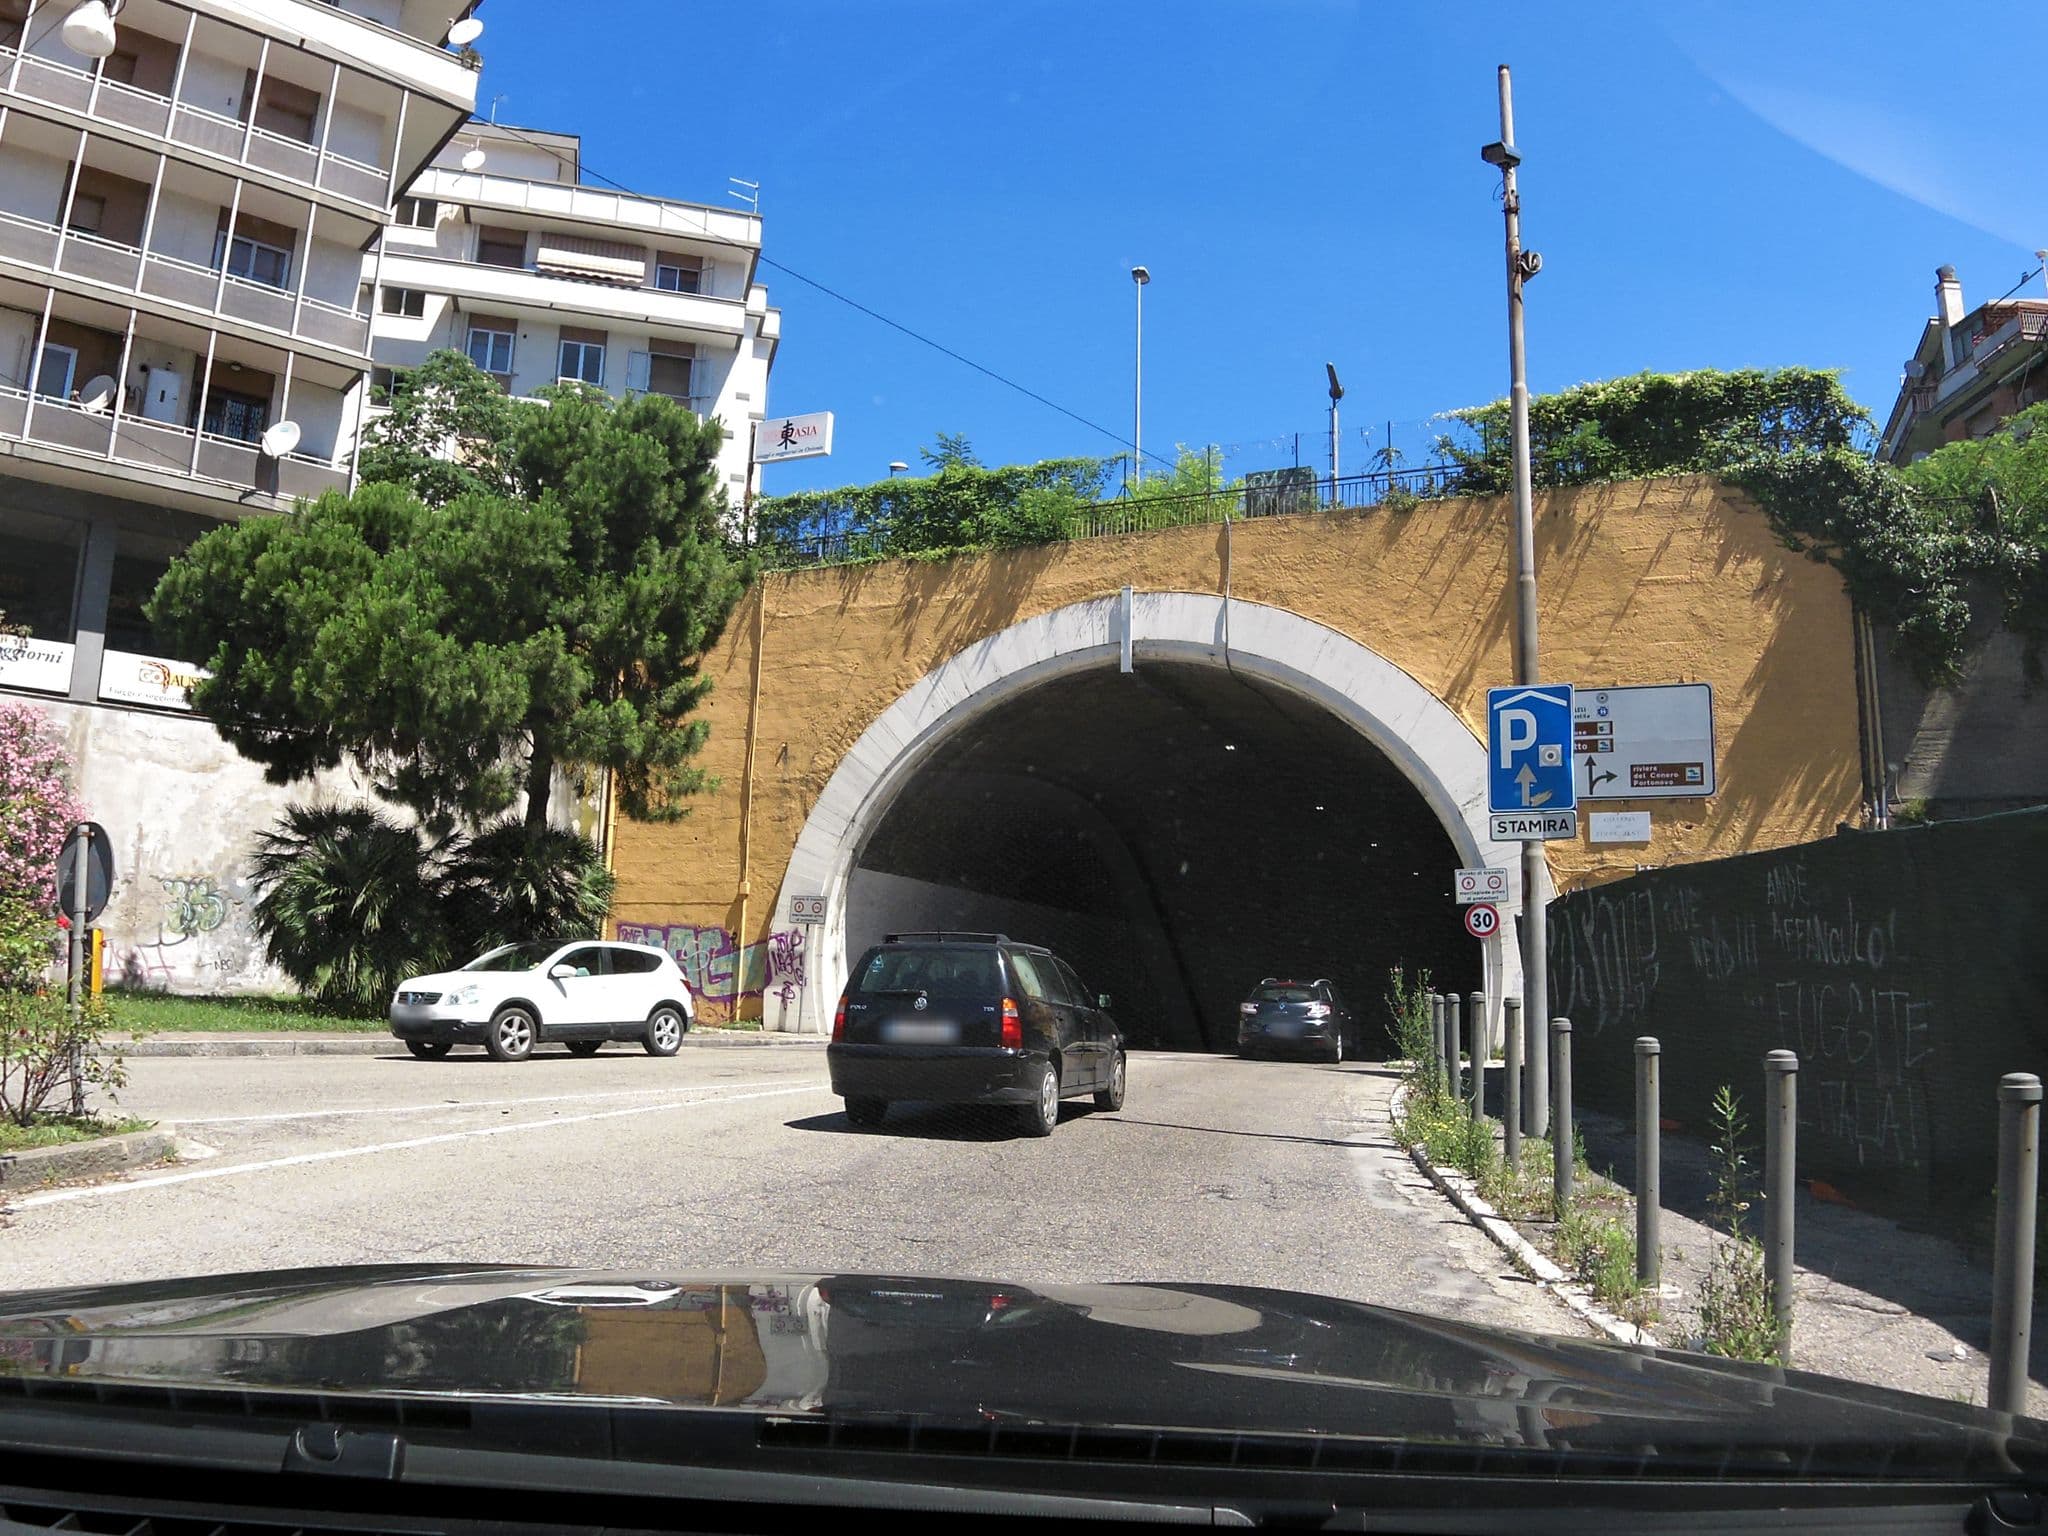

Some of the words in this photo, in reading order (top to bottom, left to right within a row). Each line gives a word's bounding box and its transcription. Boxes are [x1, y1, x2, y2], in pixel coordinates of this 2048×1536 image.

[777, 419, 797, 450] 東
[794, 425, 817, 438] ASIA
[1499, 708, 1537, 769] P
[1497, 817, 1570, 834] STAMIRA
[1473, 912, 1492, 928] 30
